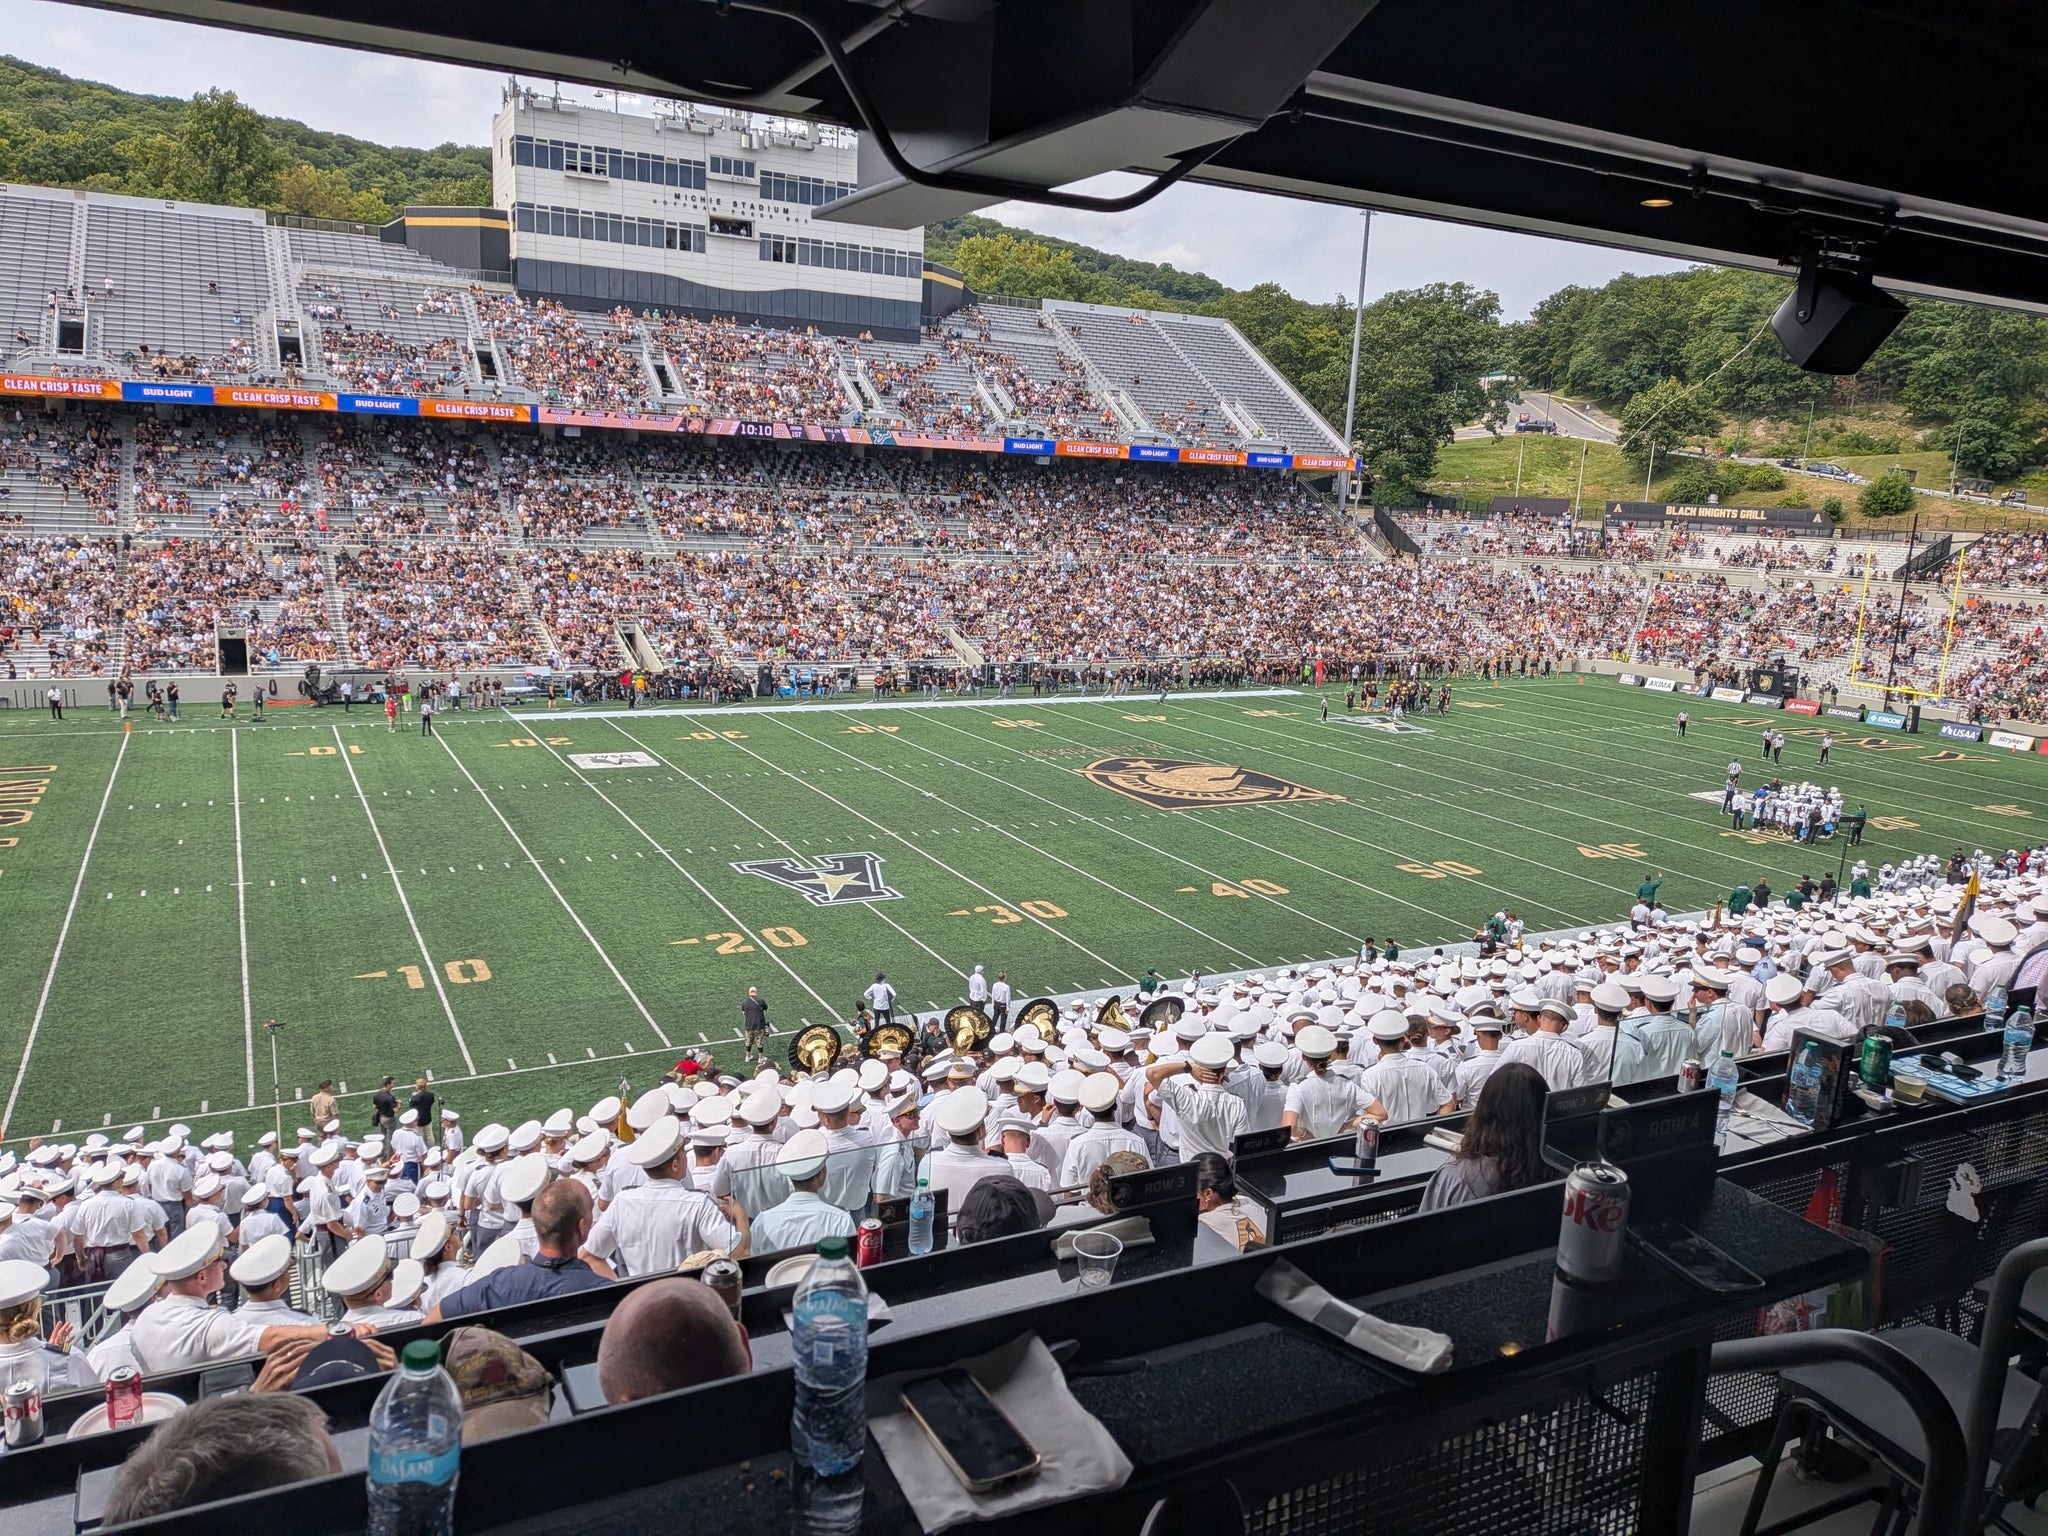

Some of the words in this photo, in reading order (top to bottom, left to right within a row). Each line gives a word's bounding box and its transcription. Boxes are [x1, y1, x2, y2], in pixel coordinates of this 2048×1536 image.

[674, 193, 722, 205] MICHIE
[733, 201, 789, 214] STADIUM
[732, 209, 773, 219] PRESS
[4, 378, 38, 391] CLEAN
[40, 380, 70, 393] CRISP
[72, 381, 102, 395] TASTE
[143, 387, 161, 398] BUD
[162, 388, 193, 399] LIGHT
[232, 391, 263, 402] CLEAN
[264, 392, 290, 404] CRISP
[292, 394, 321, 406] TASTE
[355, 399, 371, 409] BUD
[372, 400, 400, 410] LIGHT
[435, 403, 463, 414] CLEAN
[465, 404, 488, 416] CRISP
[490, 406, 515, 417] TASTE
[716, 422, 723, 432] 7
[741, 424, 772, 435] 10:10
[857, 432, 862, 442] 7
[1012, 442, 1024, 450] BUD
[1026, 442, 1043, 451] LIGHT
[1066, 445, 1084, 453] CLEAN
[1086, 445, 1101, 454] CRISP
[1102, 446, 1119, 455] TASTE
[1153, 450, 1168, 458] LIGHT
[1188, 452, 1206, 460] CLEAN
[1207, 453, 1221, 461] CRISP
[1222, 454, 1237, 462] TASTE
[1302, 458, 1317, 466] CLEAN
[1318, 459, 1332, 467] CRISP
[1333, 460, 1347, 468] TASTE
[1613, 504, 1622, 512] A
[1665, 506, 1696, 516] BLACK
[1698, 508, 1738, 518] KNIGHTS
[1740, 510, 1767, 520] GRILL
[1812, 514, 1821, 523] A
[1828, 708, 1860, 719] EXCHANGE
[1878, 716, 1901, 725] EMCOR
[1953, 728, 1977, 739] USAA
[1705, 717, 2000, 762] ARMY
[1998, 736, 2024, 746] stryker
[1395, 860, 1483, 879] 50
[1211, 879, 1291, 899] 40
[975, 900, 1069, 924] 30
[705, 926, 808, 955] 20
[396, 958, 493, 990] 10
[1557, 1099, 1578, 1110] ROW
[1580, 1096, 1586, 1106] 3
[1648, 1117, 1686, 1138] ROW
[1144, 1179, 1175, 1195] ROW
[1177, 1176, 1185, 1188] 3
[380, 1458, 434, 1480] DASANI
